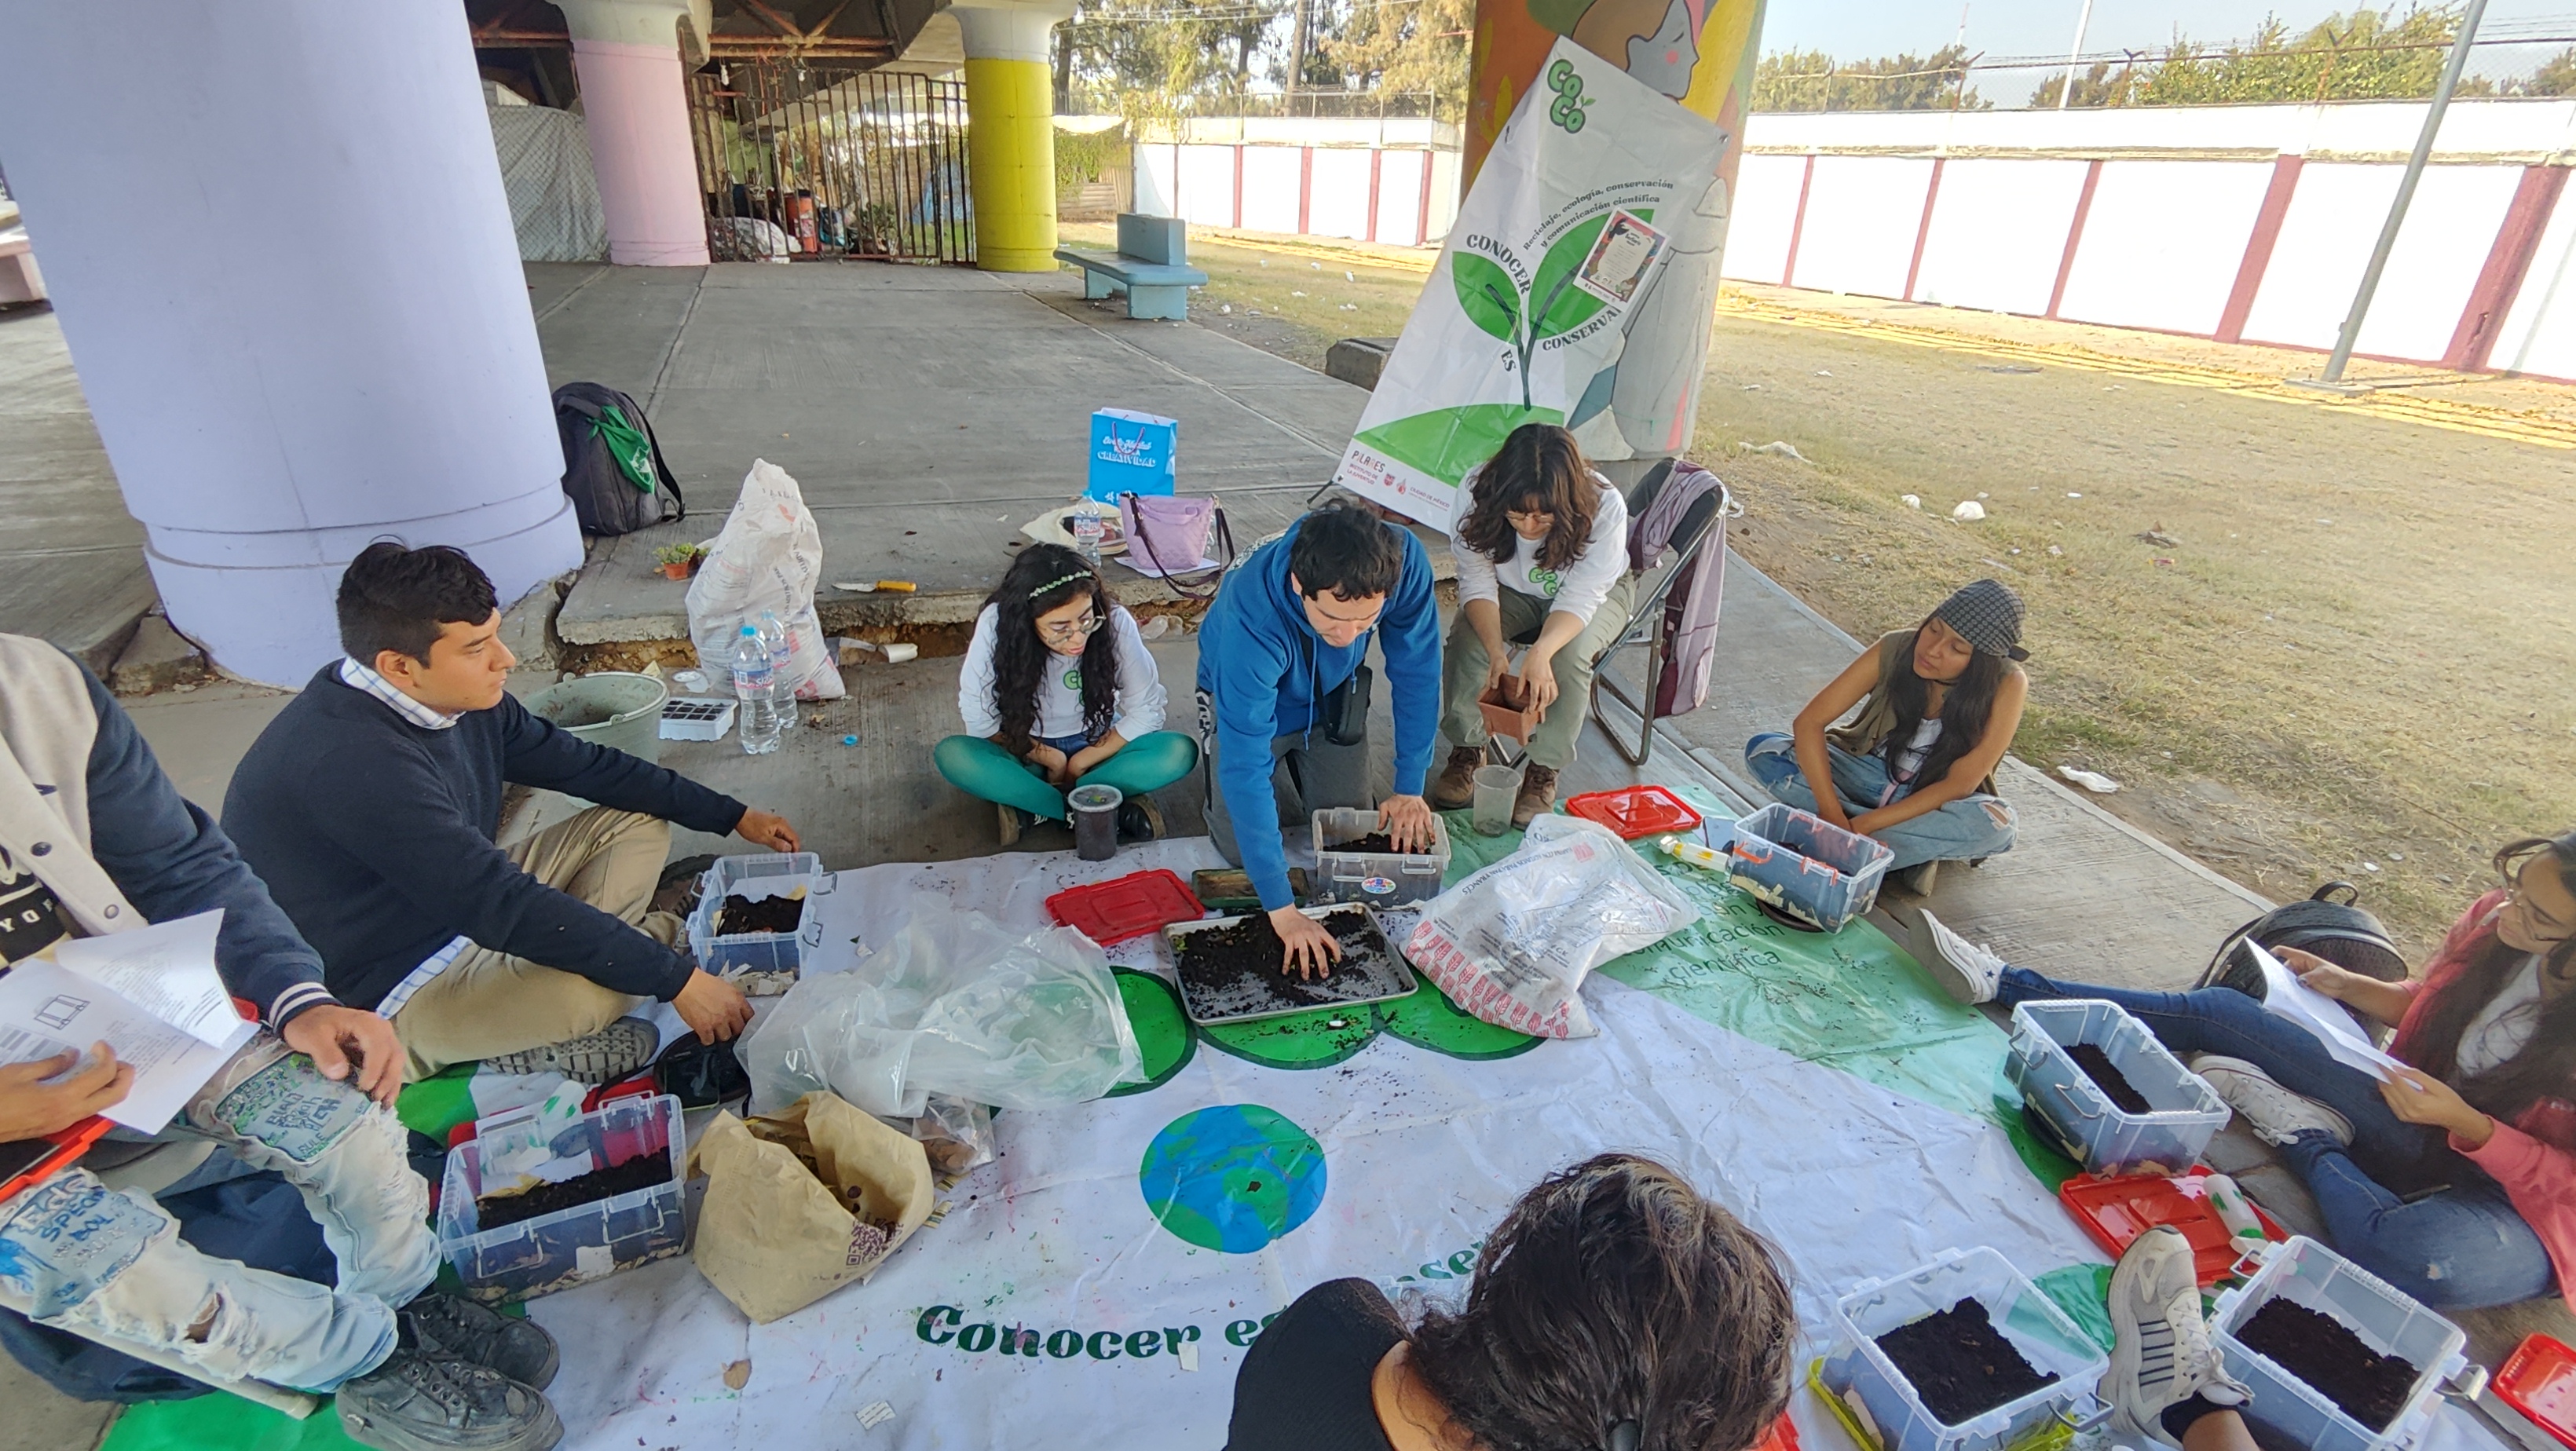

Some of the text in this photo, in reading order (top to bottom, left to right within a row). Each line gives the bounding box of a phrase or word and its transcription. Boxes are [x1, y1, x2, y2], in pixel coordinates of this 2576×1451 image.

[1522, 179, 1674, 250] Reciclaje, ecología, conservación
[1547, 202, 1610, 240] comunicación
[1613, 194, 1659, 206] científica
[1466, 234, 1531, 294] CONOCER
[1501, 349, 1517, 372] ES
[1410, 487, 1426, 498] CIUDAD
[1462, 872, 1492, 895] FRANCÉS
[1670, 951, 1782, 979] científica
[916, 1304, 1202, 1360] Conocer
